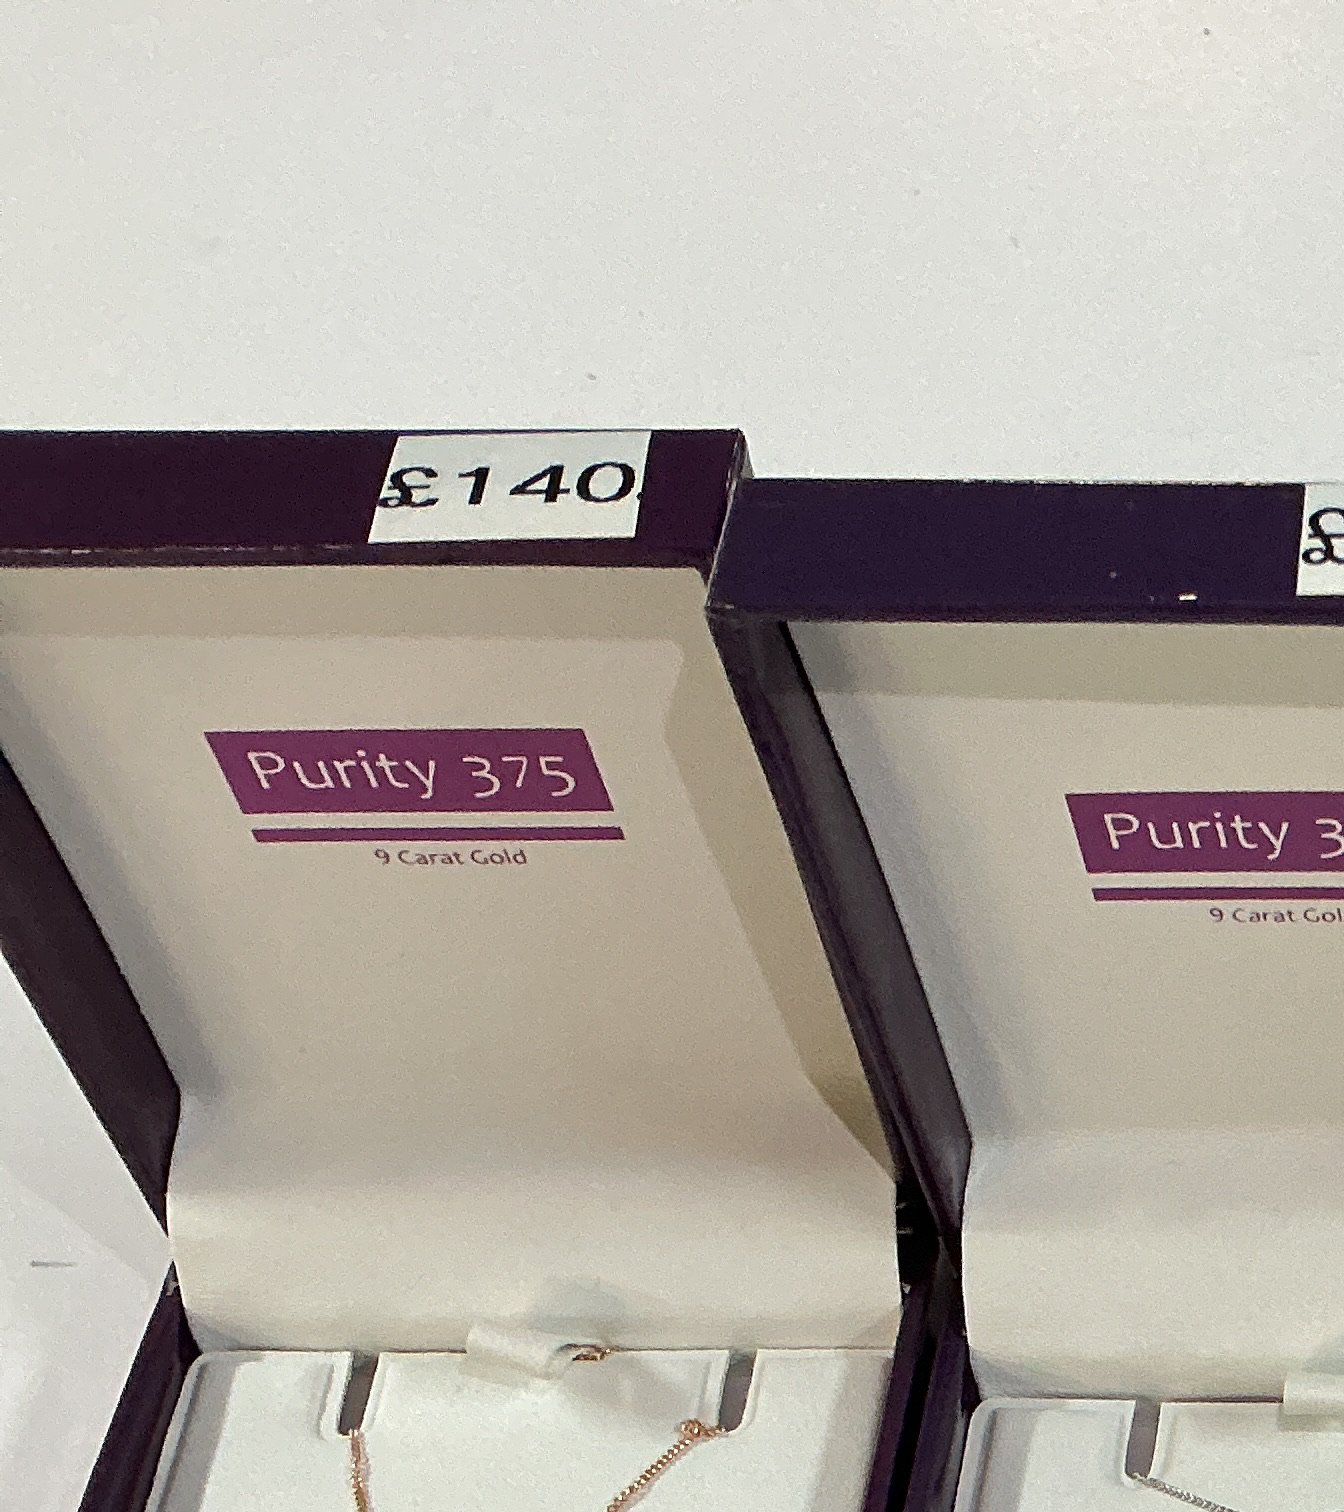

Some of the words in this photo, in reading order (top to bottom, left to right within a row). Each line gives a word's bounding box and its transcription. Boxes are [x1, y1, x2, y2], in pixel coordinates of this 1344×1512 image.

[378, 461, 637, 509] £140
[247, 749, 436, 800] Purity
[462, 755, 576, 799] 375
[374, 848, 391, 865] 9
[397, 849, 465, 866] Carat
[470, 848, 528, 866] Gold
[1103, 811, 1289, 861] Purity
[1209, 907, 1224, 923] 9
[1231, 907, 1296, 924] Carat
